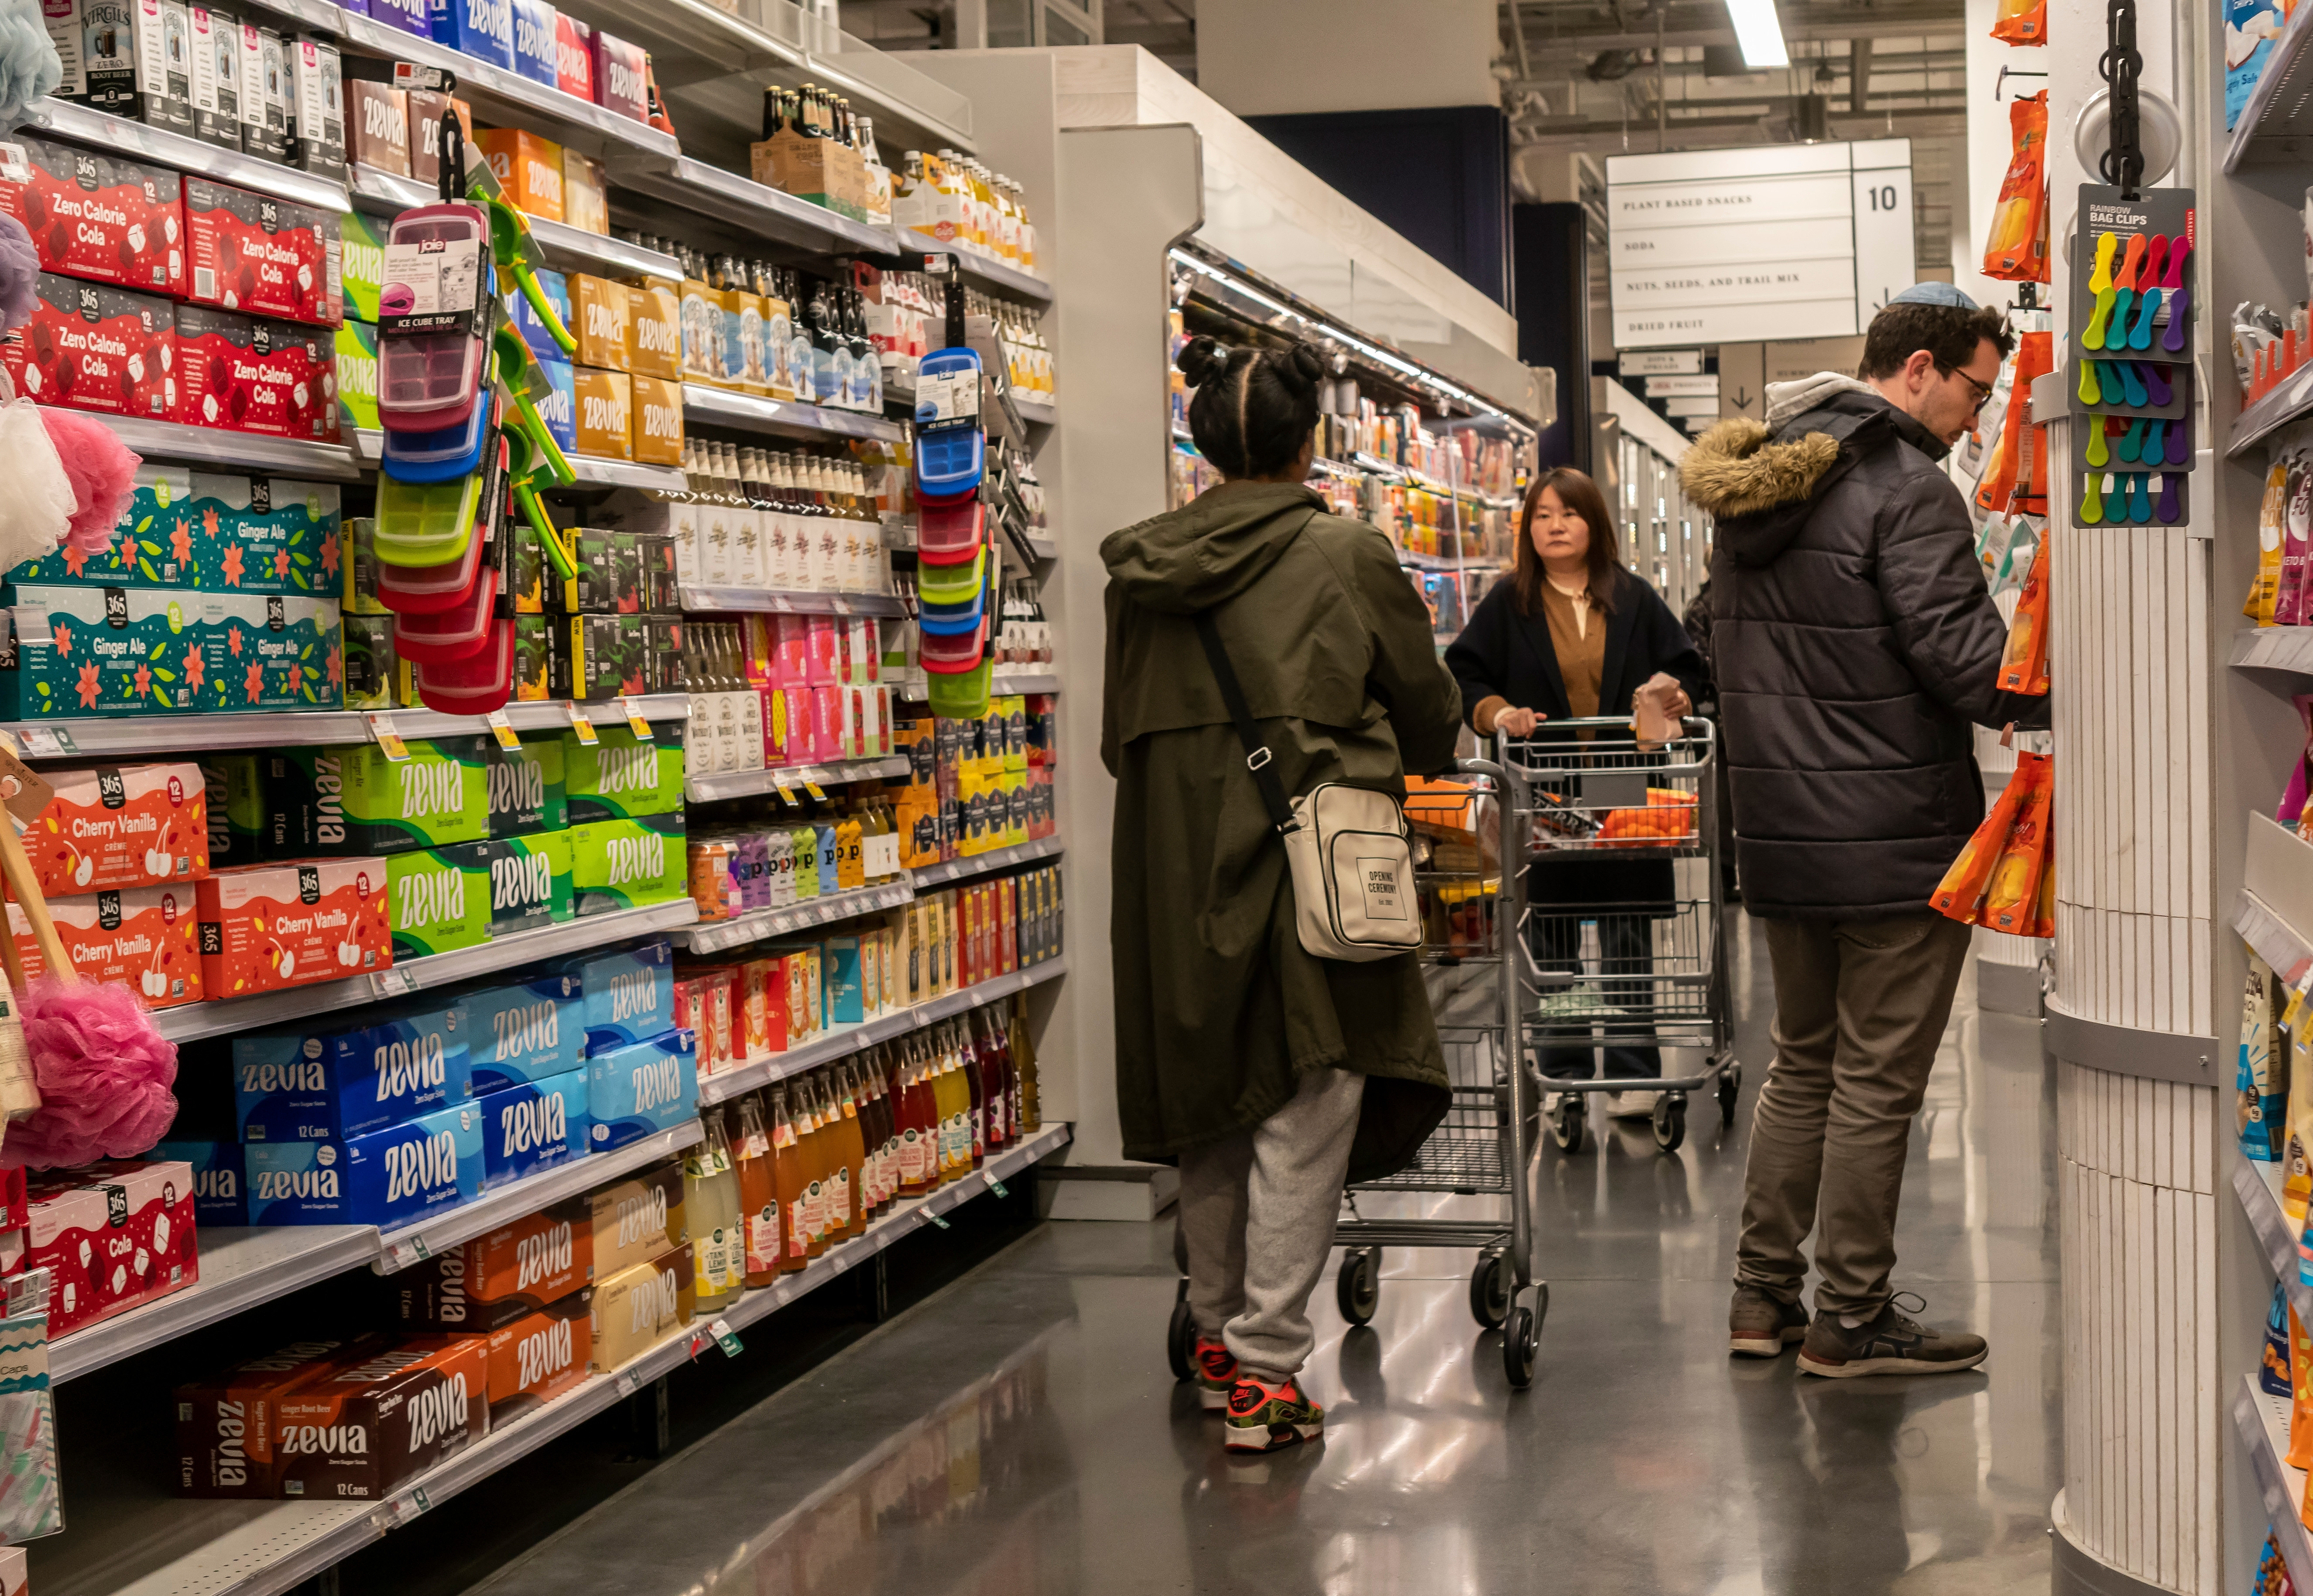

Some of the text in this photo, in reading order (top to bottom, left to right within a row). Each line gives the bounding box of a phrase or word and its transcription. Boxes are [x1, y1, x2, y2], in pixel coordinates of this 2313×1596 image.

[82, 6, 130, 28] VIRGIL'S
[96, 60, 123, 68] ZERO
[610, 62, 643, 102] zevia
[364, 96, 405, 148] zevia
[77, 157, 96, 177] 365
[144, 181, 154, 197] 12
[528, 160, 561, 202] zevia
[1624, 195, 1752, 211] PLANT BASED SNACKS
[1869, 185, 1897, 211] 10
[52, 193, 127, 226] Zero Calorie
[262, 203, 277, 222] 365
[2090, 204, 2131, 214] RAINBOW
[2090, 212, 2147, 225] BAG CLIPS
[77, 223, 105, 246] Cola
[313, 225, 322, 239] 12
[243, 236, 299, 266] Zero Calorie
[420, 239, 444, 253] joie
[1624, 241, 1655, 250] SODA
[343, 240, 383, 285] evia
[261, 264, 283, 284] Cola
[1627, 274, 1799, 291] NUTS, SEEDS, AND TRAIL MIX
[80, 289, 98, 309] 365
[141, 311, 152, 327] 12
[412, 318, 433, 326] CUBE
[434, 316, 456, 325] TRAY
[588, 303, 623, 343] zevia
[1629, 319, 1704, 332] DRIED FRUIT
[59, 327, 127, 356] Zero Calorie
[253, 325, 269, 343] 365
[637, 315, 675, 354] zevia
[306, 342, 316, 356] 12
[83, 356, 108, 377] Cola
[234, 360, 293, 385] Zero Calorie
[253, 385, 276, 405] Cola
[584, 395, 625, 433] zevia
[644, 404, 680, 440] zevia
[158, 484, 168, 497] 12
[251, 484, 270, 502] 365
[237, 522, 286, 541] Ginger Ale
[106, 596, 126, 616] 365
[170, 607, 179, 622] 12
[269, 602, 282, 619] 365
[93, 638, 146, 659] Ginger Ale
[257, 640, 298, 658] Ginger Ale
[597, 743, 659, 795] zevia
[101, 776, 123, 795] 365
[169, 781, 181, 796] 12
[400, 760, 463, 819] zevia
[488, 760, 544, 814] zevia
[315, 757, 345, 844] zevia
[73, 813, 157, 838] Cherry Vanilla
[274, 823, 286, 844] Cans
[607, 832, 664, 886] zevia
[300, 874, 317, 892] 365
[358, 877, 367, 889] 12
[492, 851, 552, 910] zevia
[1369, 871, 1393, 882] OPENING
[398, 867, 465, 930] zevia
[1368, 883, 1396, 894] CEREMONY
[100, 897, 119, 915] 365
[163, 900, 174, 914] 12
[276, 909, 347, 935] Cherry Vanilla
[202, 925, 218, 952] 365
[73, 938, 151, 963] Cherry Vanilla
[610, 966, 657, 1024] zevia
[493, 999, 559, 1062] zevia
[242, 1062, 326, 1092] zevia
[374, 1032, 445, 1102] zevia
[632, 1055, 681, 1114] zevia
[298, 1126, 329, 1138] 12 Cans
[502, 1091, 566, 1158] zevia
[385, 1130, 457, 1203] zevia
[164, 1186, 173, 1202] 12
[257, 1169, 340, 1199] zevia
[109, 1194, 127, 1214] 365
[617, 1185, 666, 1249] zevia
[109, 1234, 133, 1257] Cola
[517, 1221, 572, 1291] zevia
[440, 1243, 466, 1322] zevia
[631, 1267, 677, 1335] zevia
[517, 1318, 572, 1391] zevia
[0, 1363, 28, 1375] Caps
[281, 1404, 301, 1414] Ginger
[408, 1372, 468, 1454] zevia
[217, 1400, 247, 1487] zevia
[281, 1425, 369, 1454] zevia
[336, 1483, 369, 1496] 12 Cans
